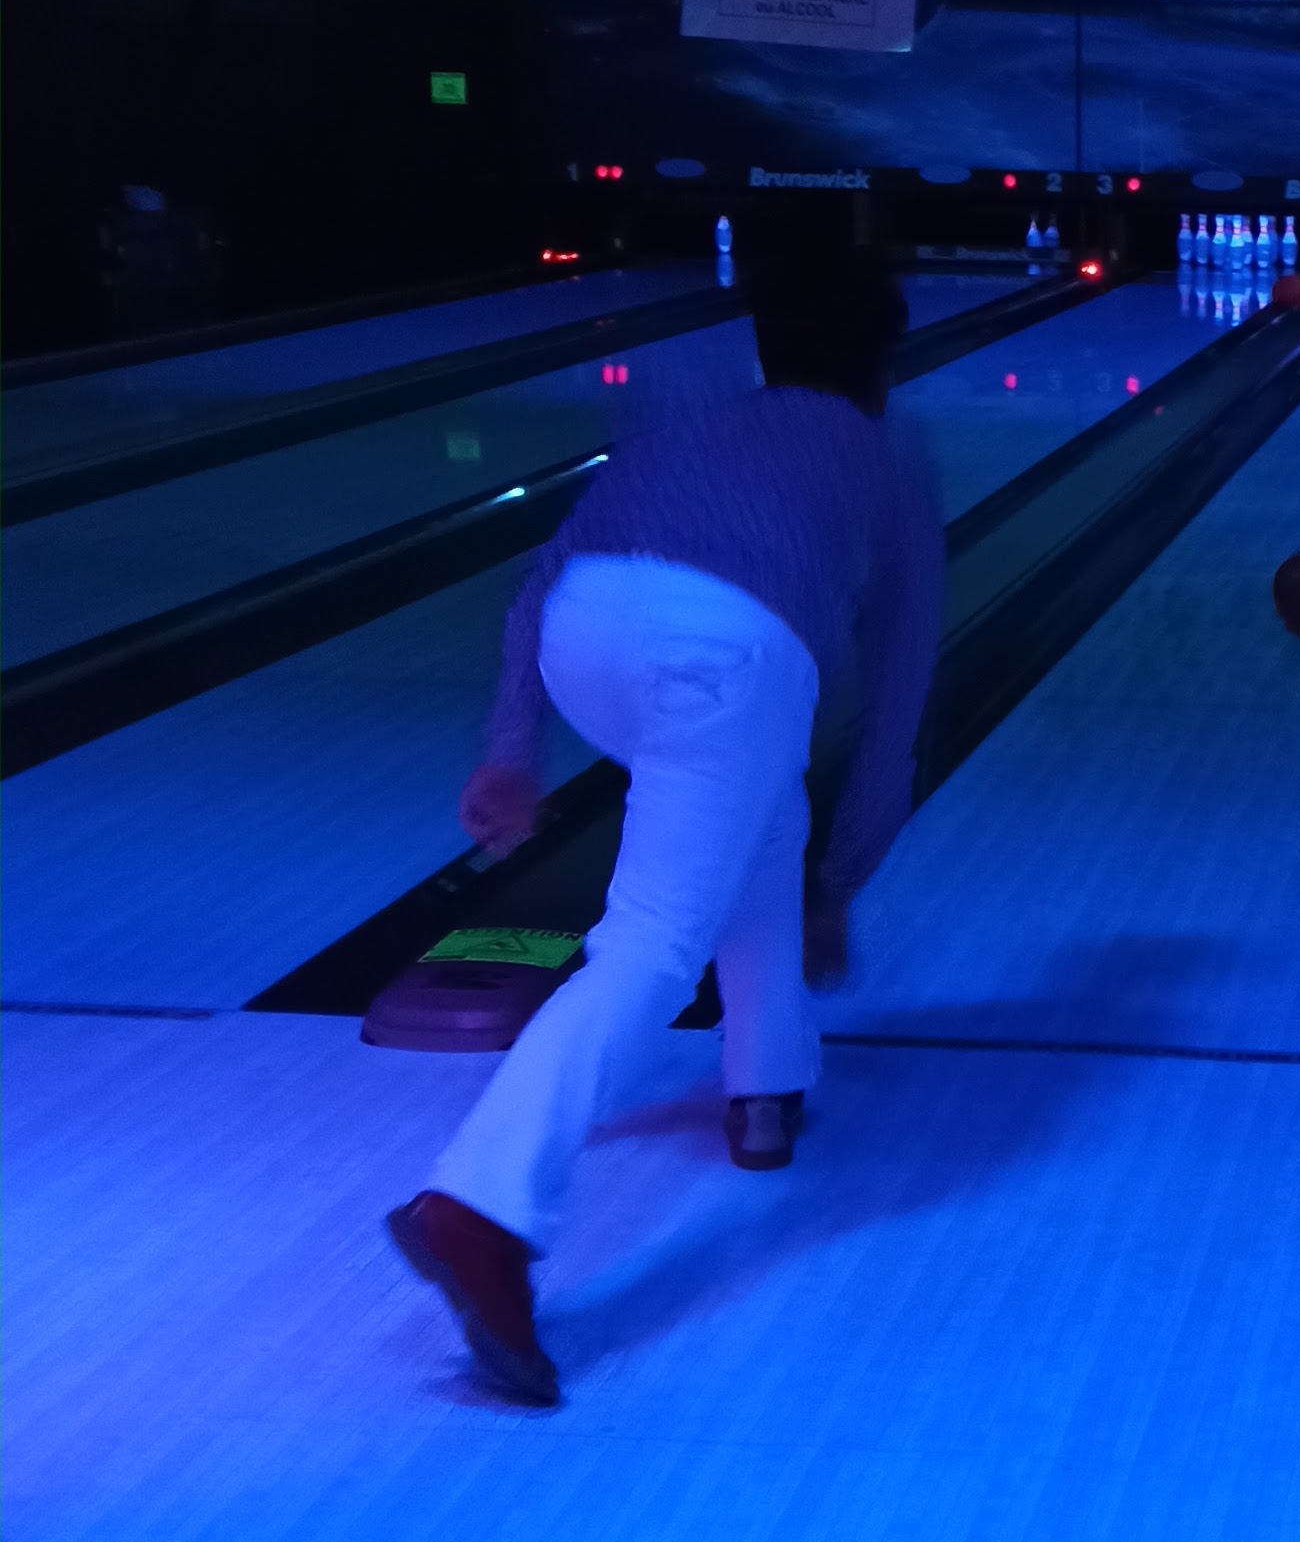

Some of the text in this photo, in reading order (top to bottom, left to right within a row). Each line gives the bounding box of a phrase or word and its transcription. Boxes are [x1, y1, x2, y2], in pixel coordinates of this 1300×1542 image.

[567, 163, 579, 182] 1
[749, 166, 871, 190] Brunswick
[1046, 173, 1063, 194] 2
[1096, 174, 1114, 196] 3
